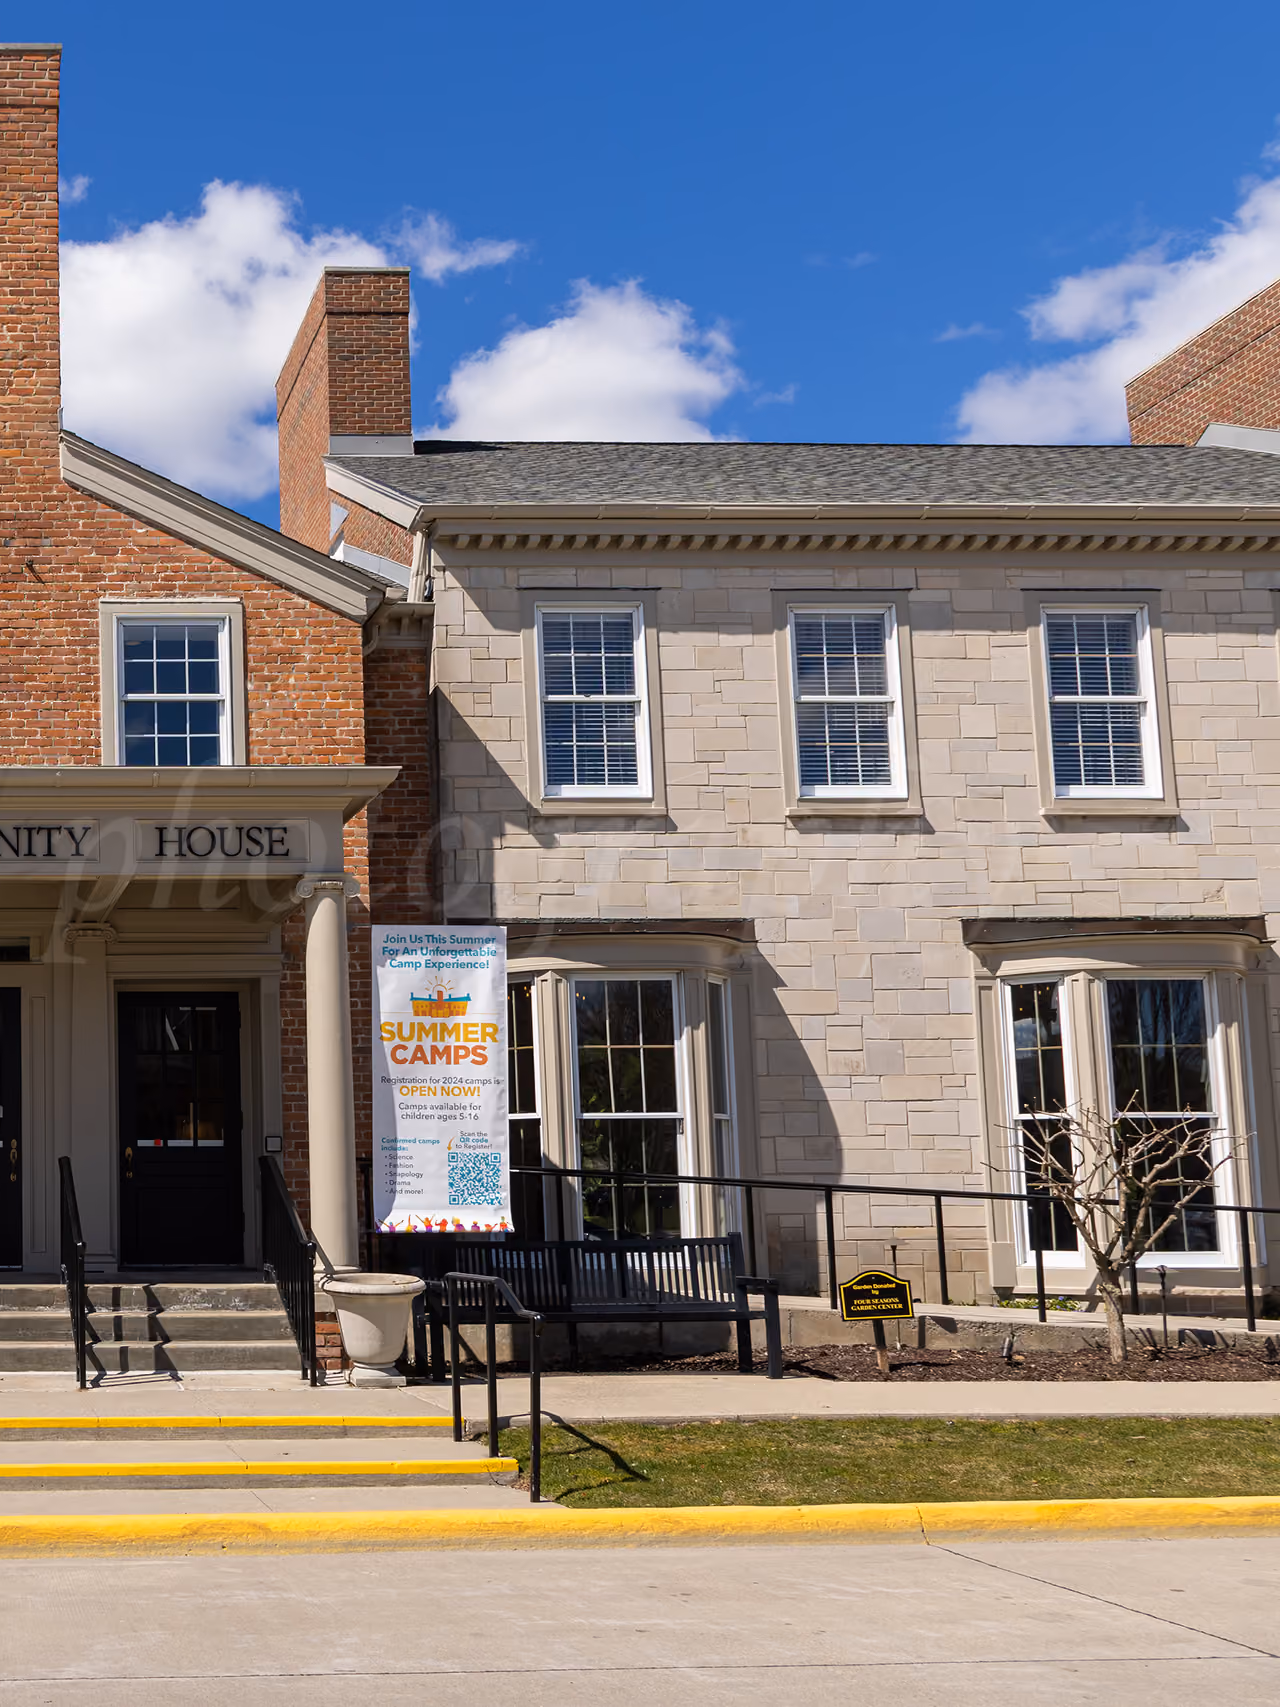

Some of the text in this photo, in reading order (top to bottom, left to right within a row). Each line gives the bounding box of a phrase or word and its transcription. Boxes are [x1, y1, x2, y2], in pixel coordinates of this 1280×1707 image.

[154, 826, 291, 858] HOUSE
[383, 934, 496, 944] Join Us This Summer
[382, 946, 497, 958] For An Unforgettable
[389, 959, 489, 970] Camp Experience!
[380, 1021, 498, 1043] SUMMER
[390, 1044, 488, 1065] CAMPS
[381, 1076, 427, 1085] Registration
[429, 1076, 441, 1084] for
[442, 1076, 463, 1084] 2024
[465, 1078, 492, 1086] camps
[399, 1085, 480, 1096] OPEN NOW!
[398, 1102, 481, 1111] Camps available for
[401, 1112, 435, 1120] children
[437, 1114, 457, 1122] ages
